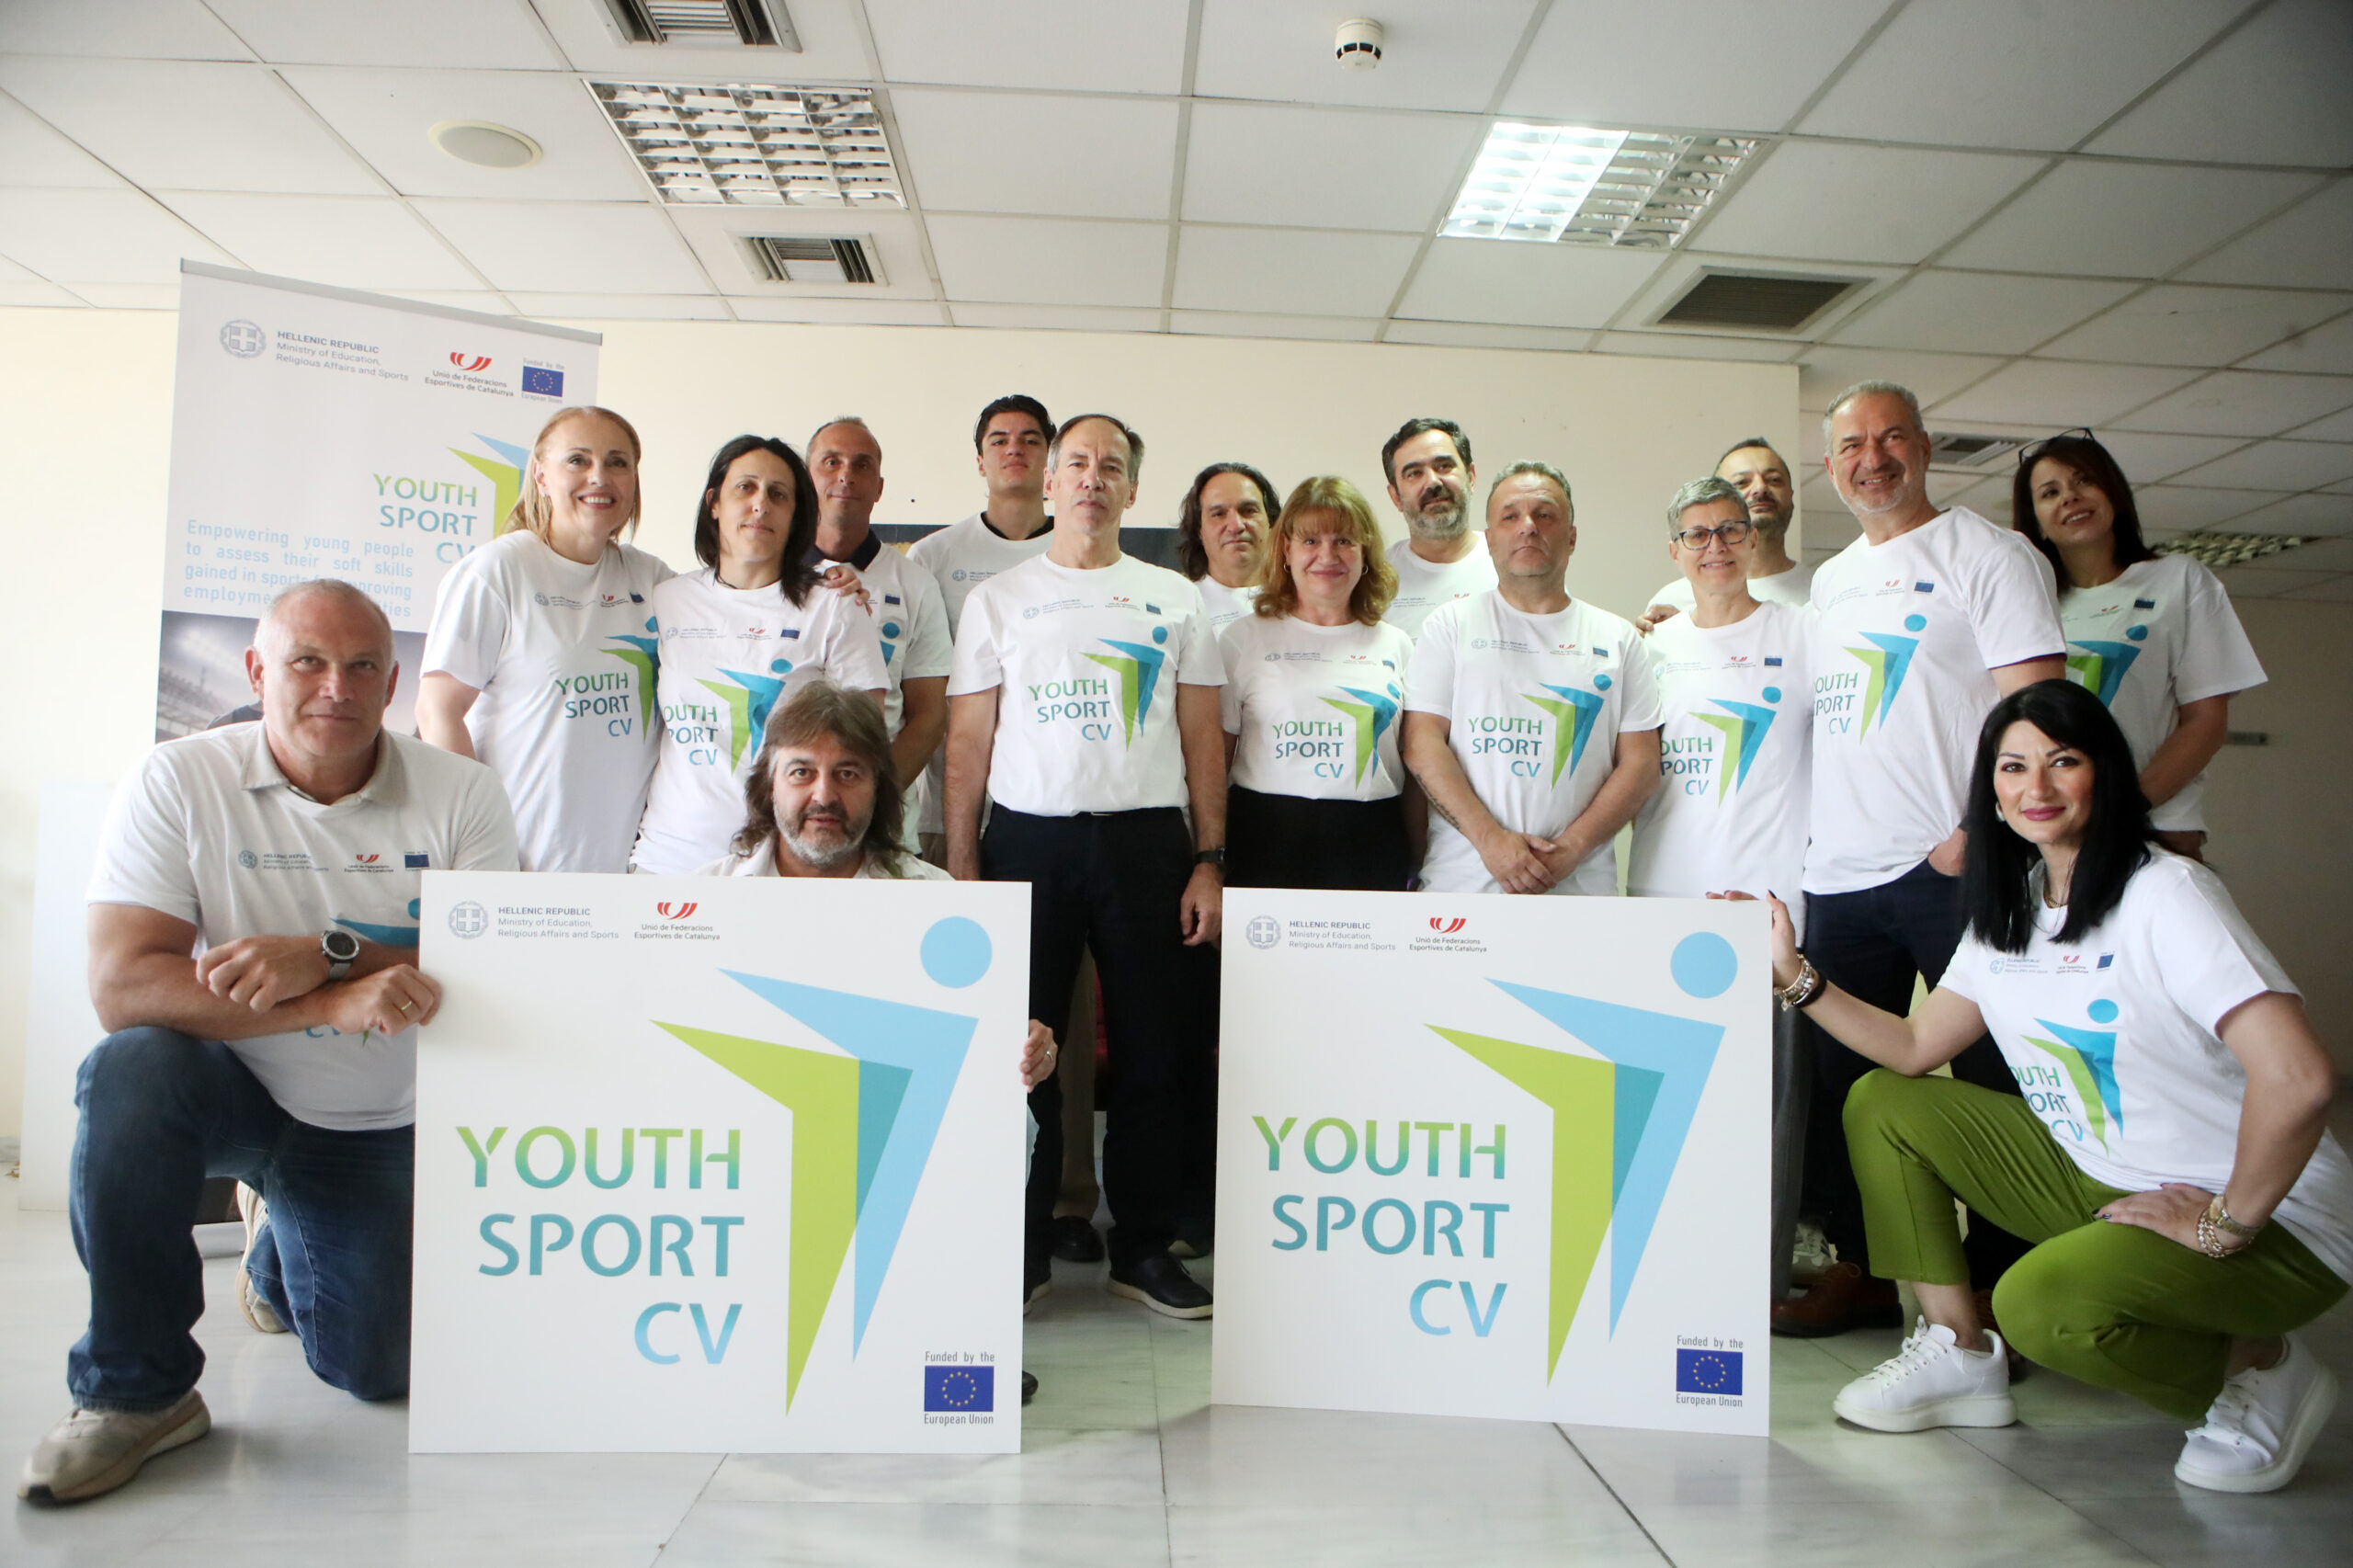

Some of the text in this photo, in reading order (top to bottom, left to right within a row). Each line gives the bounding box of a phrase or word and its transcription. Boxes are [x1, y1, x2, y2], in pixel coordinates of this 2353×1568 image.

[277, 342, 316, 357] Ministry
[318, 349, 328, 358] of
[278, 331, 380, 354] HELLENIC REPUBLIC
[276, 353, 409, 381] Religious Affairs and Sports
[373, 473, 477, 507] YOUTH
[380, 505, 477, 536] SPORT
[188, 519, 414, 559] Empowering young people
[186, 540, 413, 577] to assess their soft skills
[185, 563, 237, 582] gained
[243, 567, 256, 582] in
[184, 585, 272, 606] employme
[555, 672, 629, 696] YOUTH
[1029, 678, 1108, 701] YOUTH
[1815, 672, 1859, 694] OUTH
[564, 695, 630, 719] SPORT
[664, 704, 717, 722] OUTH
[1038, 700, 1110, 723] SPORT
[1816, 695, 1856, 716] PORT
[608, 718, 631, 737] CV
[1082, 723, 1112, 741] CV
[1273, 721, 1343, 739] YOUTH
[1468, 716, 1542, 735] YOUTH
[1829, 717, 1851, 734] CV
[1276, 741, 1344, 759] SPORT
[1472, 737, 1542, 756] SPORT
[1661, 736, 1712, 756] OUTH
[689, 749, 717, 765] CV
[1661, 757, 1713, 776] PORT
[1314, 762, 1344, 778] CV
[1510, 760, 1541, 778] CV
[1685, 779, 1710, 795] CV
[498, 906, 591, 916] HELLENIC REPUBLIC
[498, 918, 533, 927] Ministry
[535, 918, 545, 926] of
[671, 924, 713, 932] Federacions
[1290, 920, 1370, 929] HELLENIC REPUBLIC
[498, 929, 620, 940] Religious Affairs and Sports
[634, 931, 672, 940] Esportives
[685, 932, 720, 941] Catalunya
[1289, 930, 1320, 939] Ministry
[1322, 931, 1331, 939] of
[1415, 936, 1431, 944] Unió
[1442, 937, 1481, 945] Federacions
[1289, 941, 1324, 950] Religious
[1326, 941, 1352, 949] Affairs
[1370, 942, 1396, 952] Sports
[1409, 944, 1443, 953] Esportives
[1455, 945, 1487, 953] Catalunya
[1252, 1116, 1506, 1180] YOUTH
[455, 1126, 741, 1190] YOUTH
[1271, 1194, 1509, 1258] SPORT
[478, 1213, 745, 1278] SPORT
[1409, 1278, 1507, 1338] CV
[634, 1301, 743, 1366] CV
[1677, 1335, 1743, 1350] Funded by the
[925, 1351, 995, 1364] Funded by the
[1677, 1393, 1743, 1408] European Union
[924, 1414, 994, 1426] European Union
